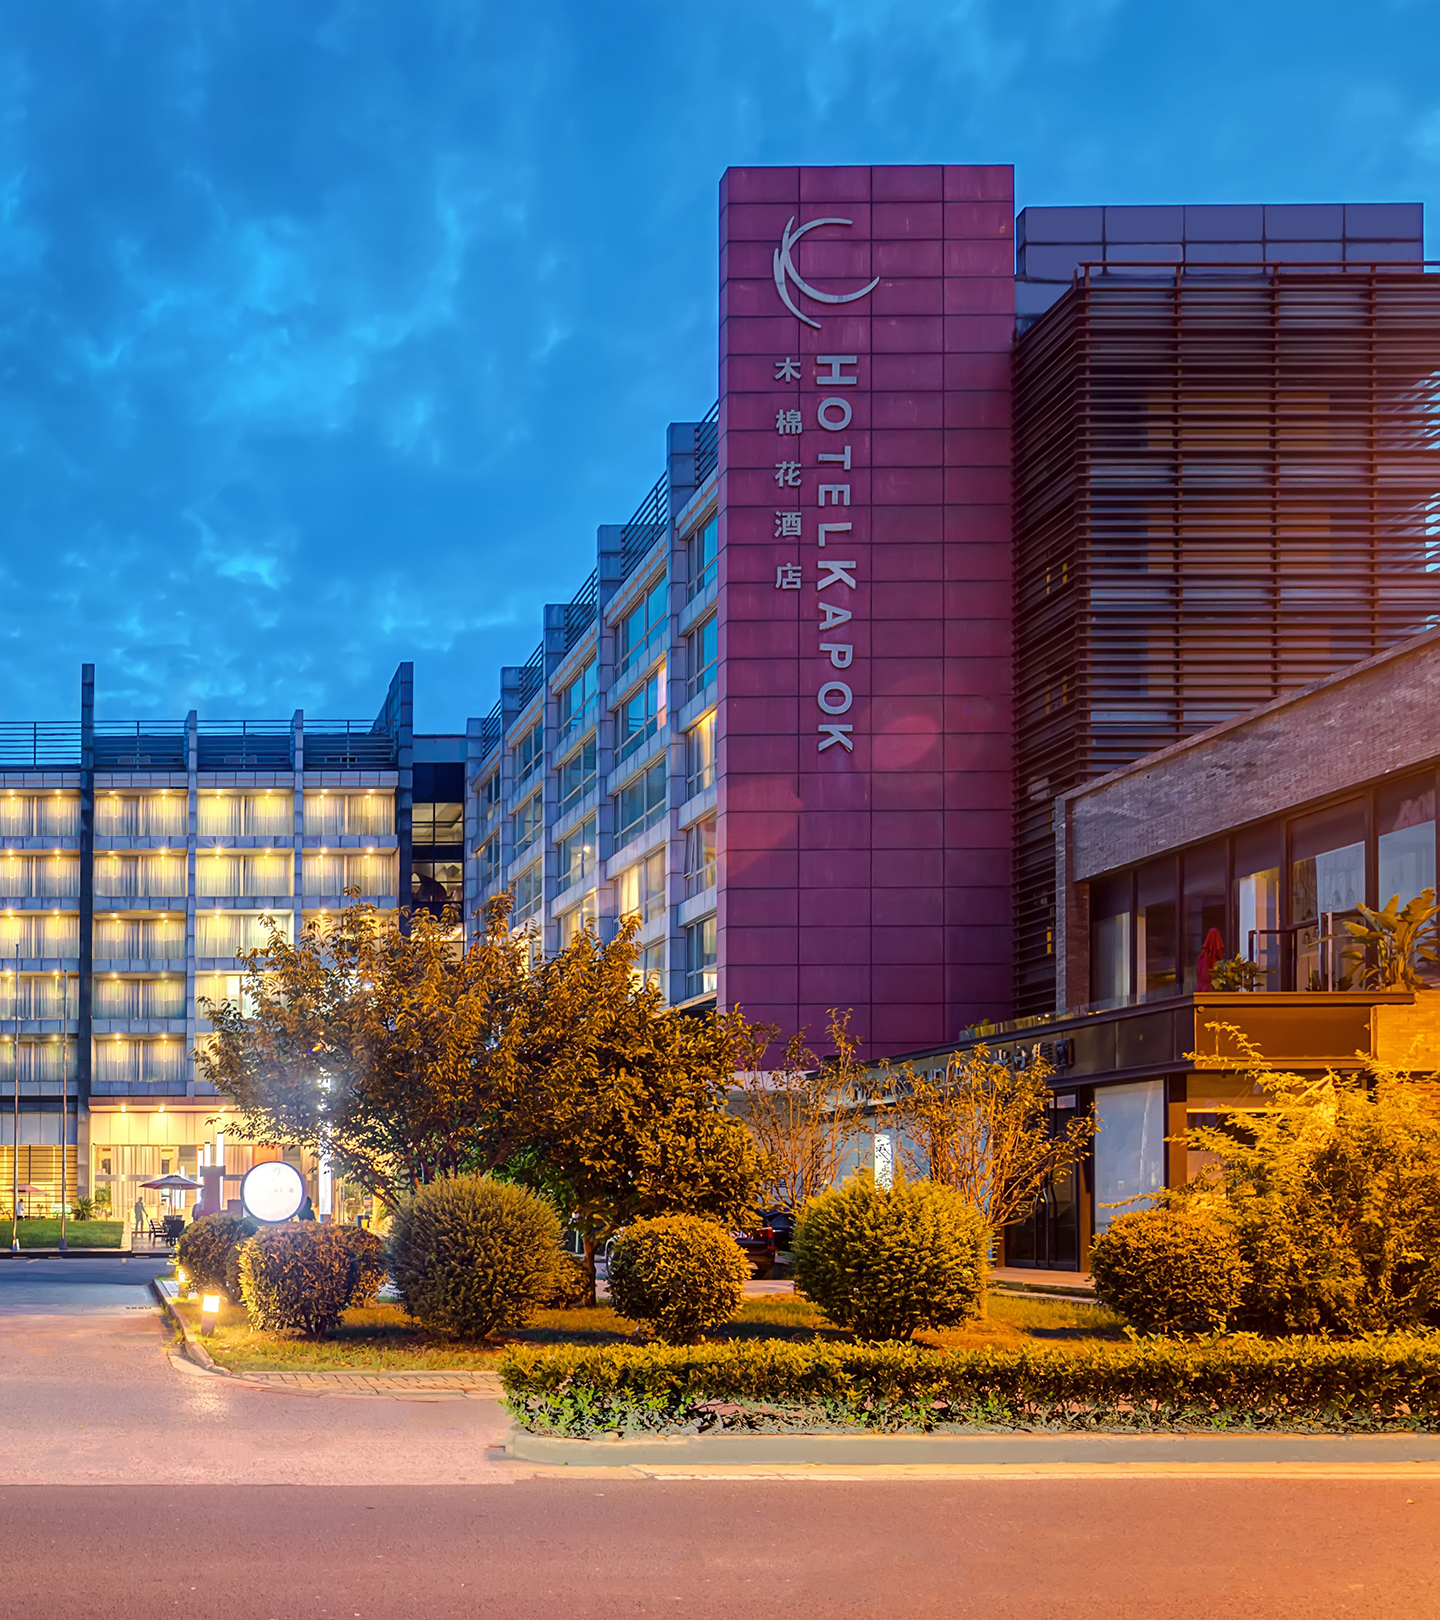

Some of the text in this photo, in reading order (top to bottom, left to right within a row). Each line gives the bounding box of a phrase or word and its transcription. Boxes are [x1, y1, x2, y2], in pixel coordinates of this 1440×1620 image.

[774, 357, 803, 590] 木棉花酒店
[816, 355, 858, 752] HOTEL KAPOK
